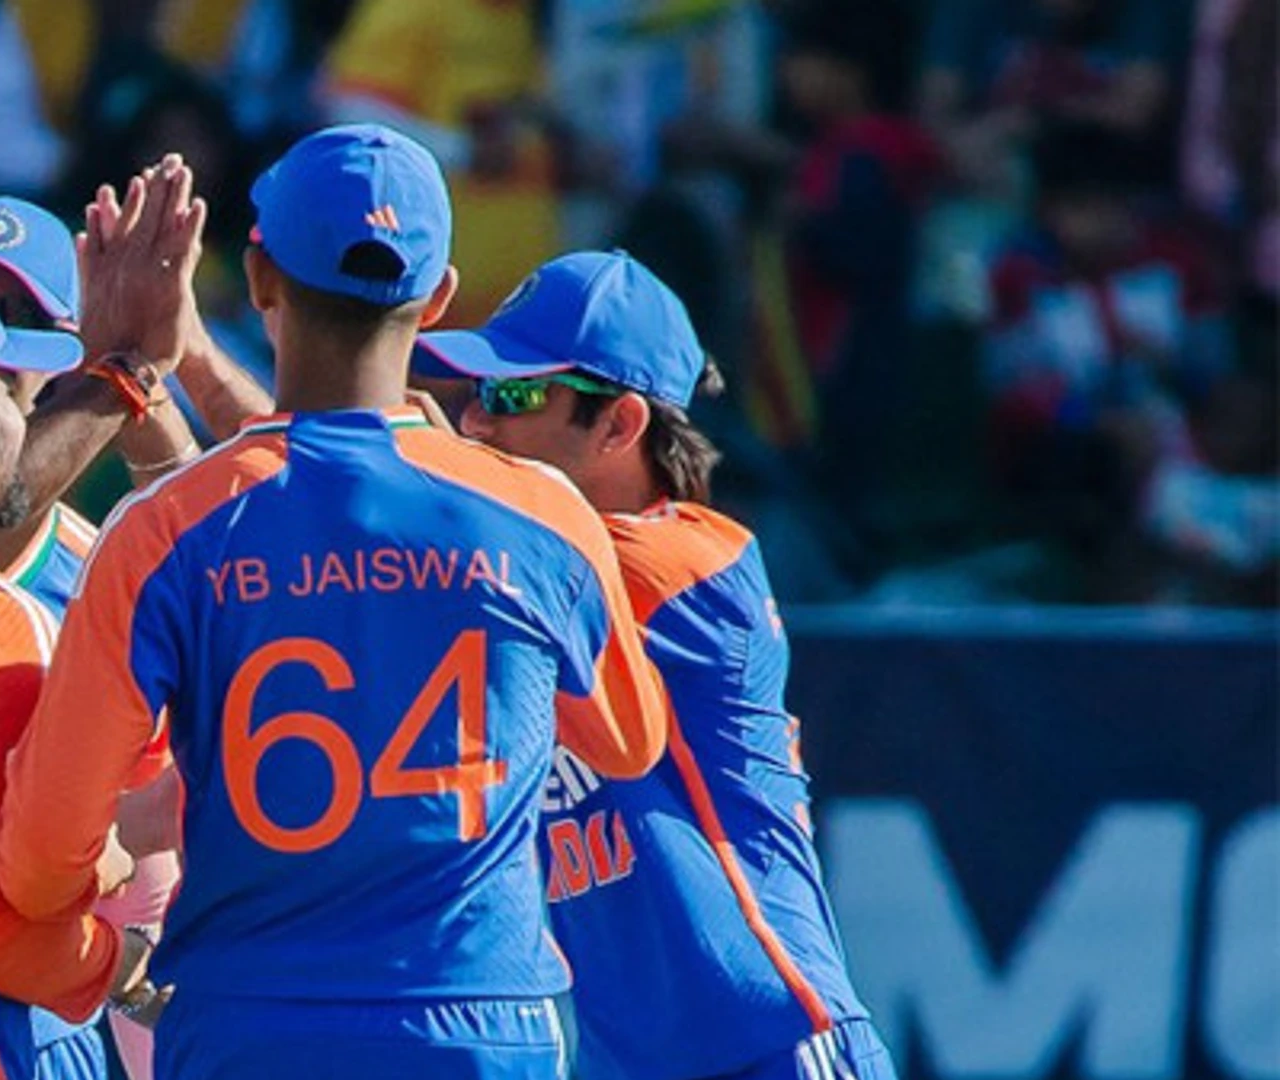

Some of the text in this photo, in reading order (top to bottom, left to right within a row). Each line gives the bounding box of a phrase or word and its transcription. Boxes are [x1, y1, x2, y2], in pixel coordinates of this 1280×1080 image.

[205, 547, 523, 605] YB JAISWAL
[221, 629, 509, 855] 64
